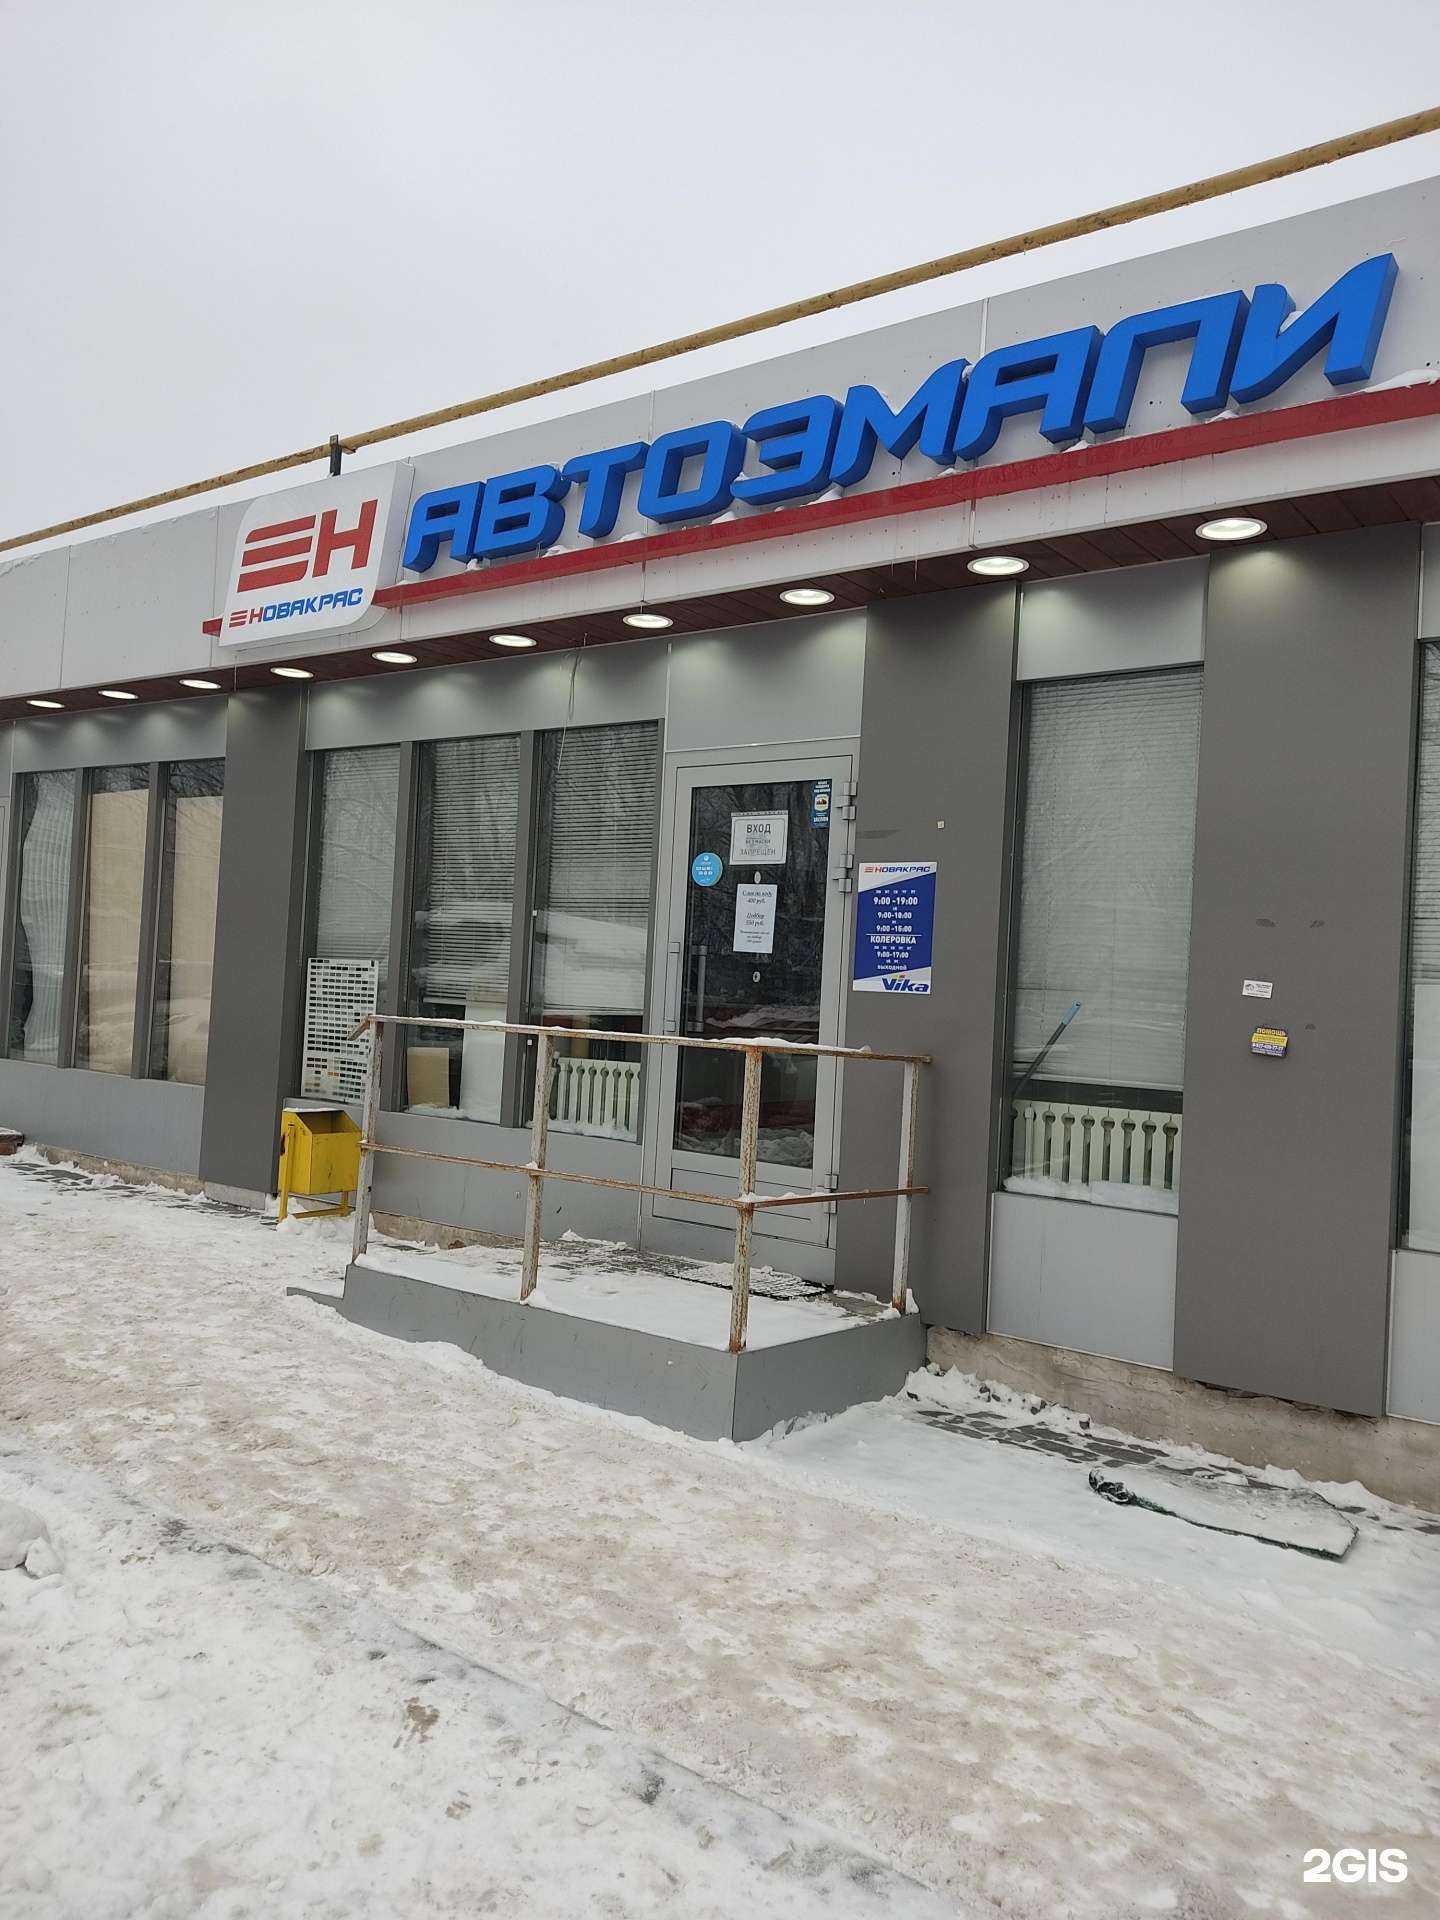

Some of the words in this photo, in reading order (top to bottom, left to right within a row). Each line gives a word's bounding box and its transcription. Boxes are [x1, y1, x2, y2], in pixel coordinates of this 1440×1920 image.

[402, 253, 1398, 571] АВТОЭМАЛИ
[746, 823, 771, 835] ВХОД
[870, 935, 917, 944] КОЛЕРОВКА
[882, 976, 929, 992] Vika
